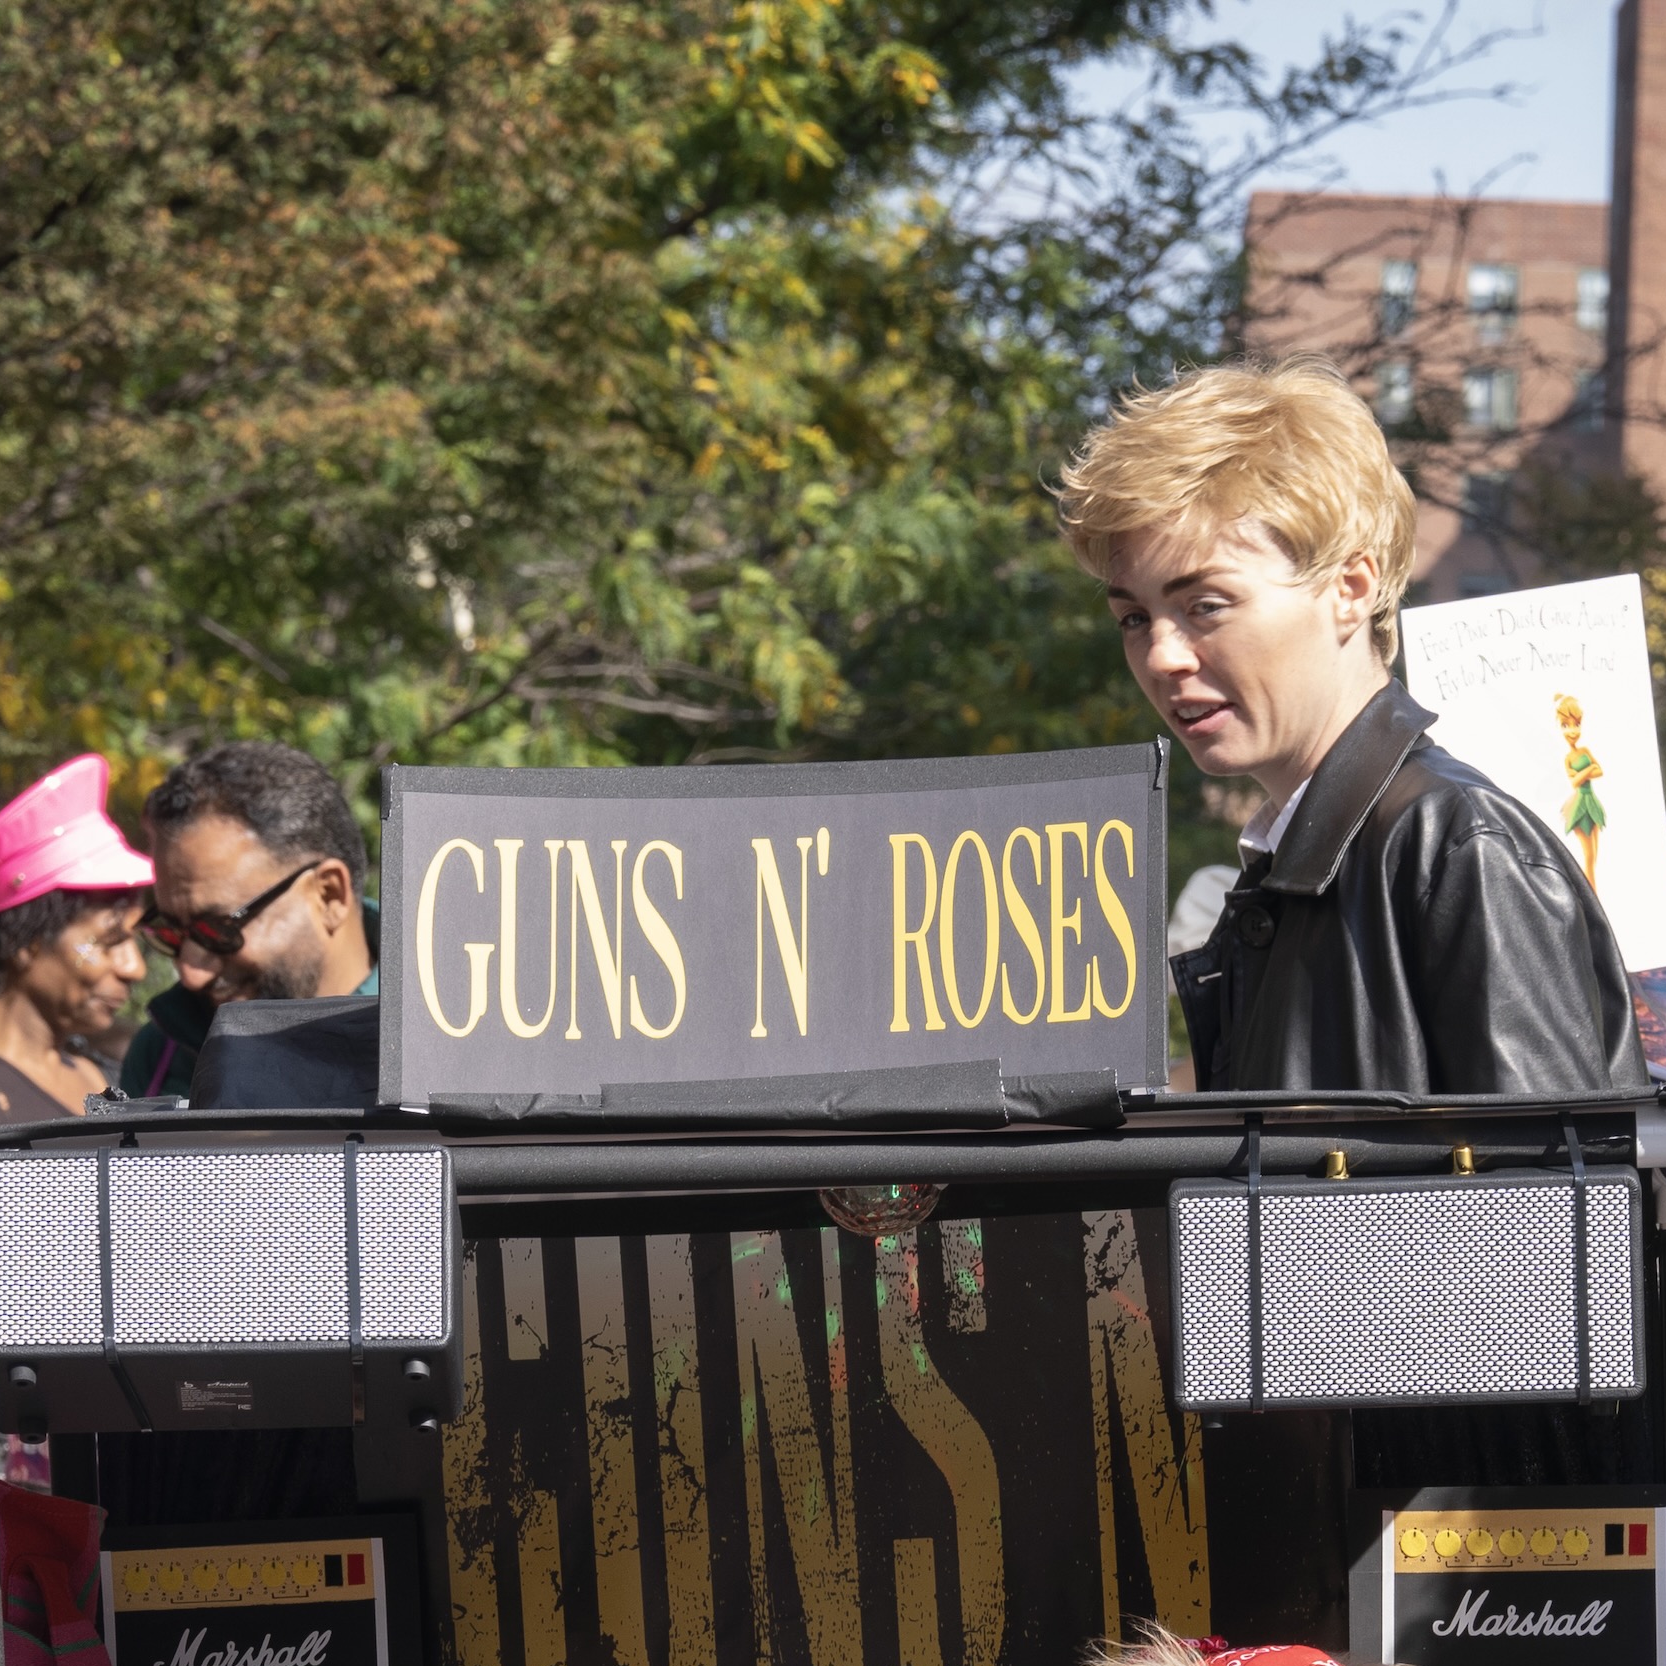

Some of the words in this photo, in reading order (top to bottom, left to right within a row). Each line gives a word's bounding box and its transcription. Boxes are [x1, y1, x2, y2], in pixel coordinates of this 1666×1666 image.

[1419, 631, 1450, 662] Free
[1495, 605, 1535, 636] Dust
[1477, 652, 1522, 685] Never
[1527, 641, 1571, 672] Never
[415, 837, 687, 1041] GUNS
[750, 826, 831, 1039] N'
[888, 818, 1138, 1035] ROSES
[1432, 1588, 1614, 1638] Marshall
